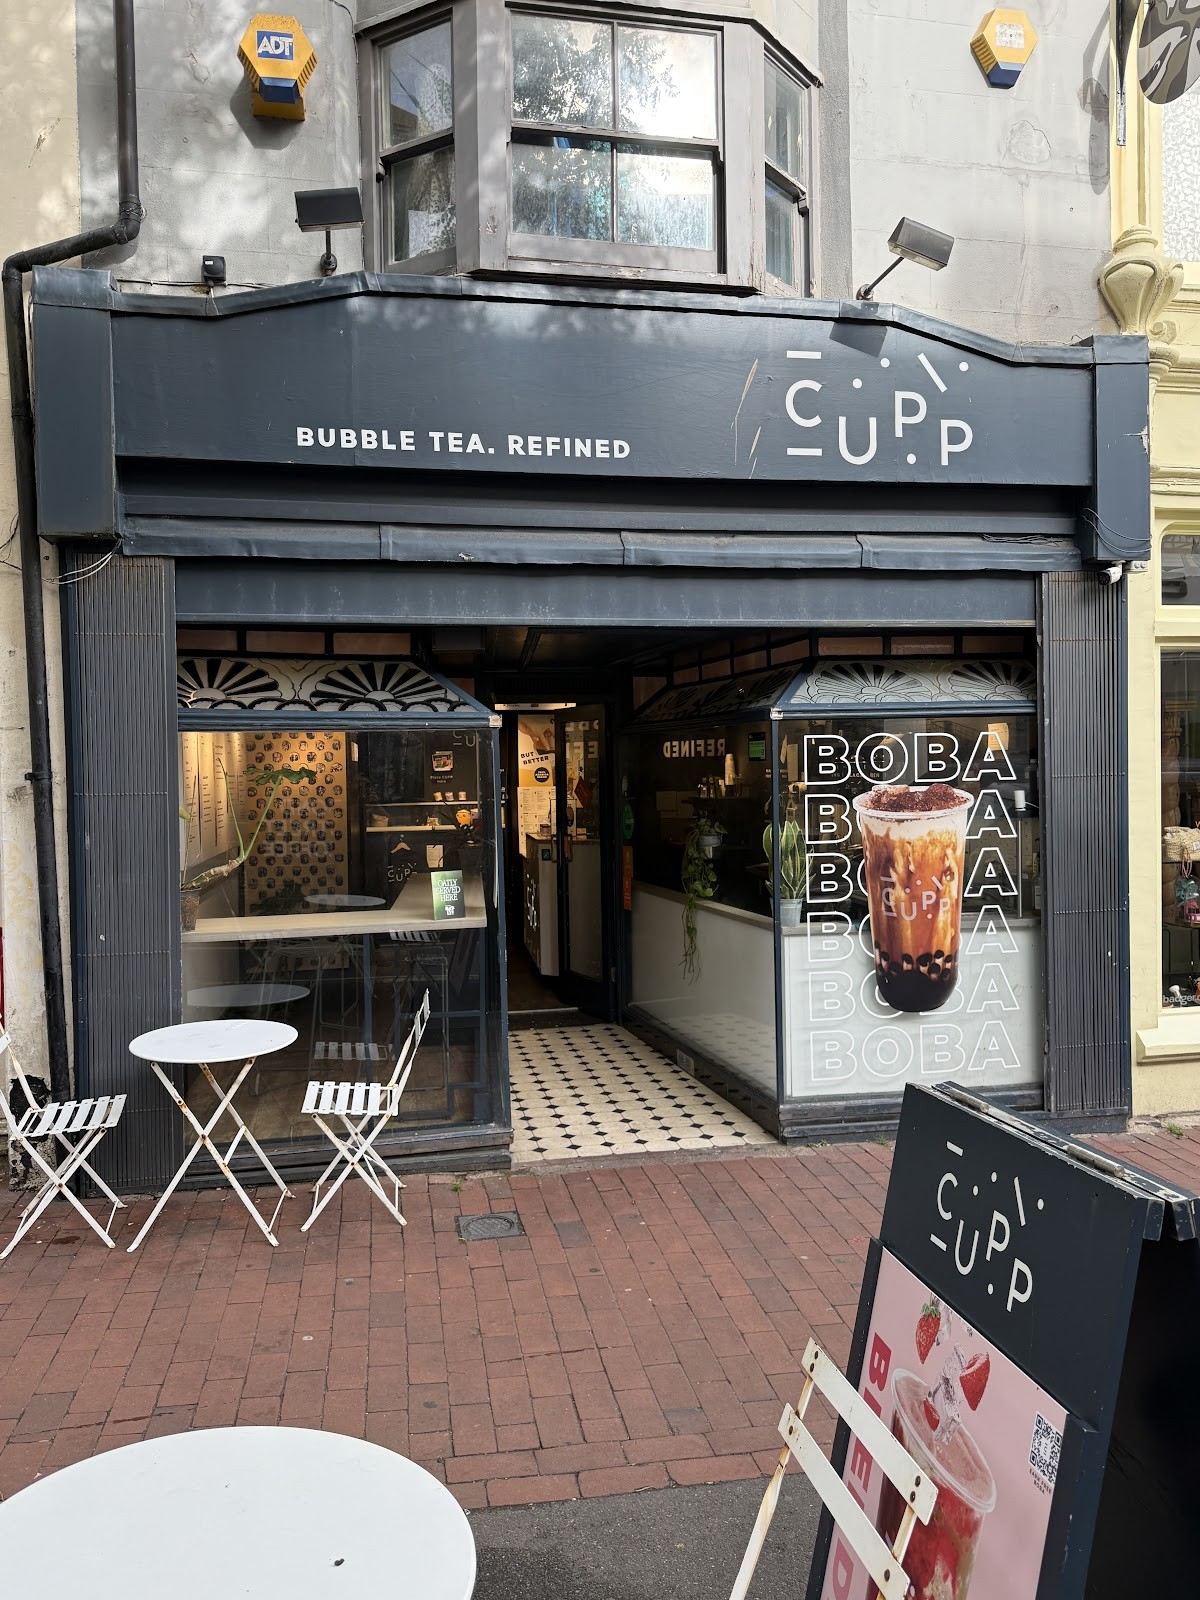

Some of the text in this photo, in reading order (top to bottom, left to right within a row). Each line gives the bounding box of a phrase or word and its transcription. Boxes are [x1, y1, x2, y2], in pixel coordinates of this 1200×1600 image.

[258, 35, 293, 56] ADT
[296, 426, 631, 459] BUBBLE TEA. REFINED
[785, 379, 974, 466] CUPP
[803, 731, 1017, 786] BOBA
[804, 789, 1018, 845] BA
[435, 886, 461, 895] SERVED
[440, 893, 458, 902] HERE
[805, 846, 1018, 904] BA
[882, 887, 951, 921] CUPP
[807, 904, 1019, 962] BA
[809, 1020, 1021, 1082] BOBA
[937, 1172, 1033, 1313] CUPP
